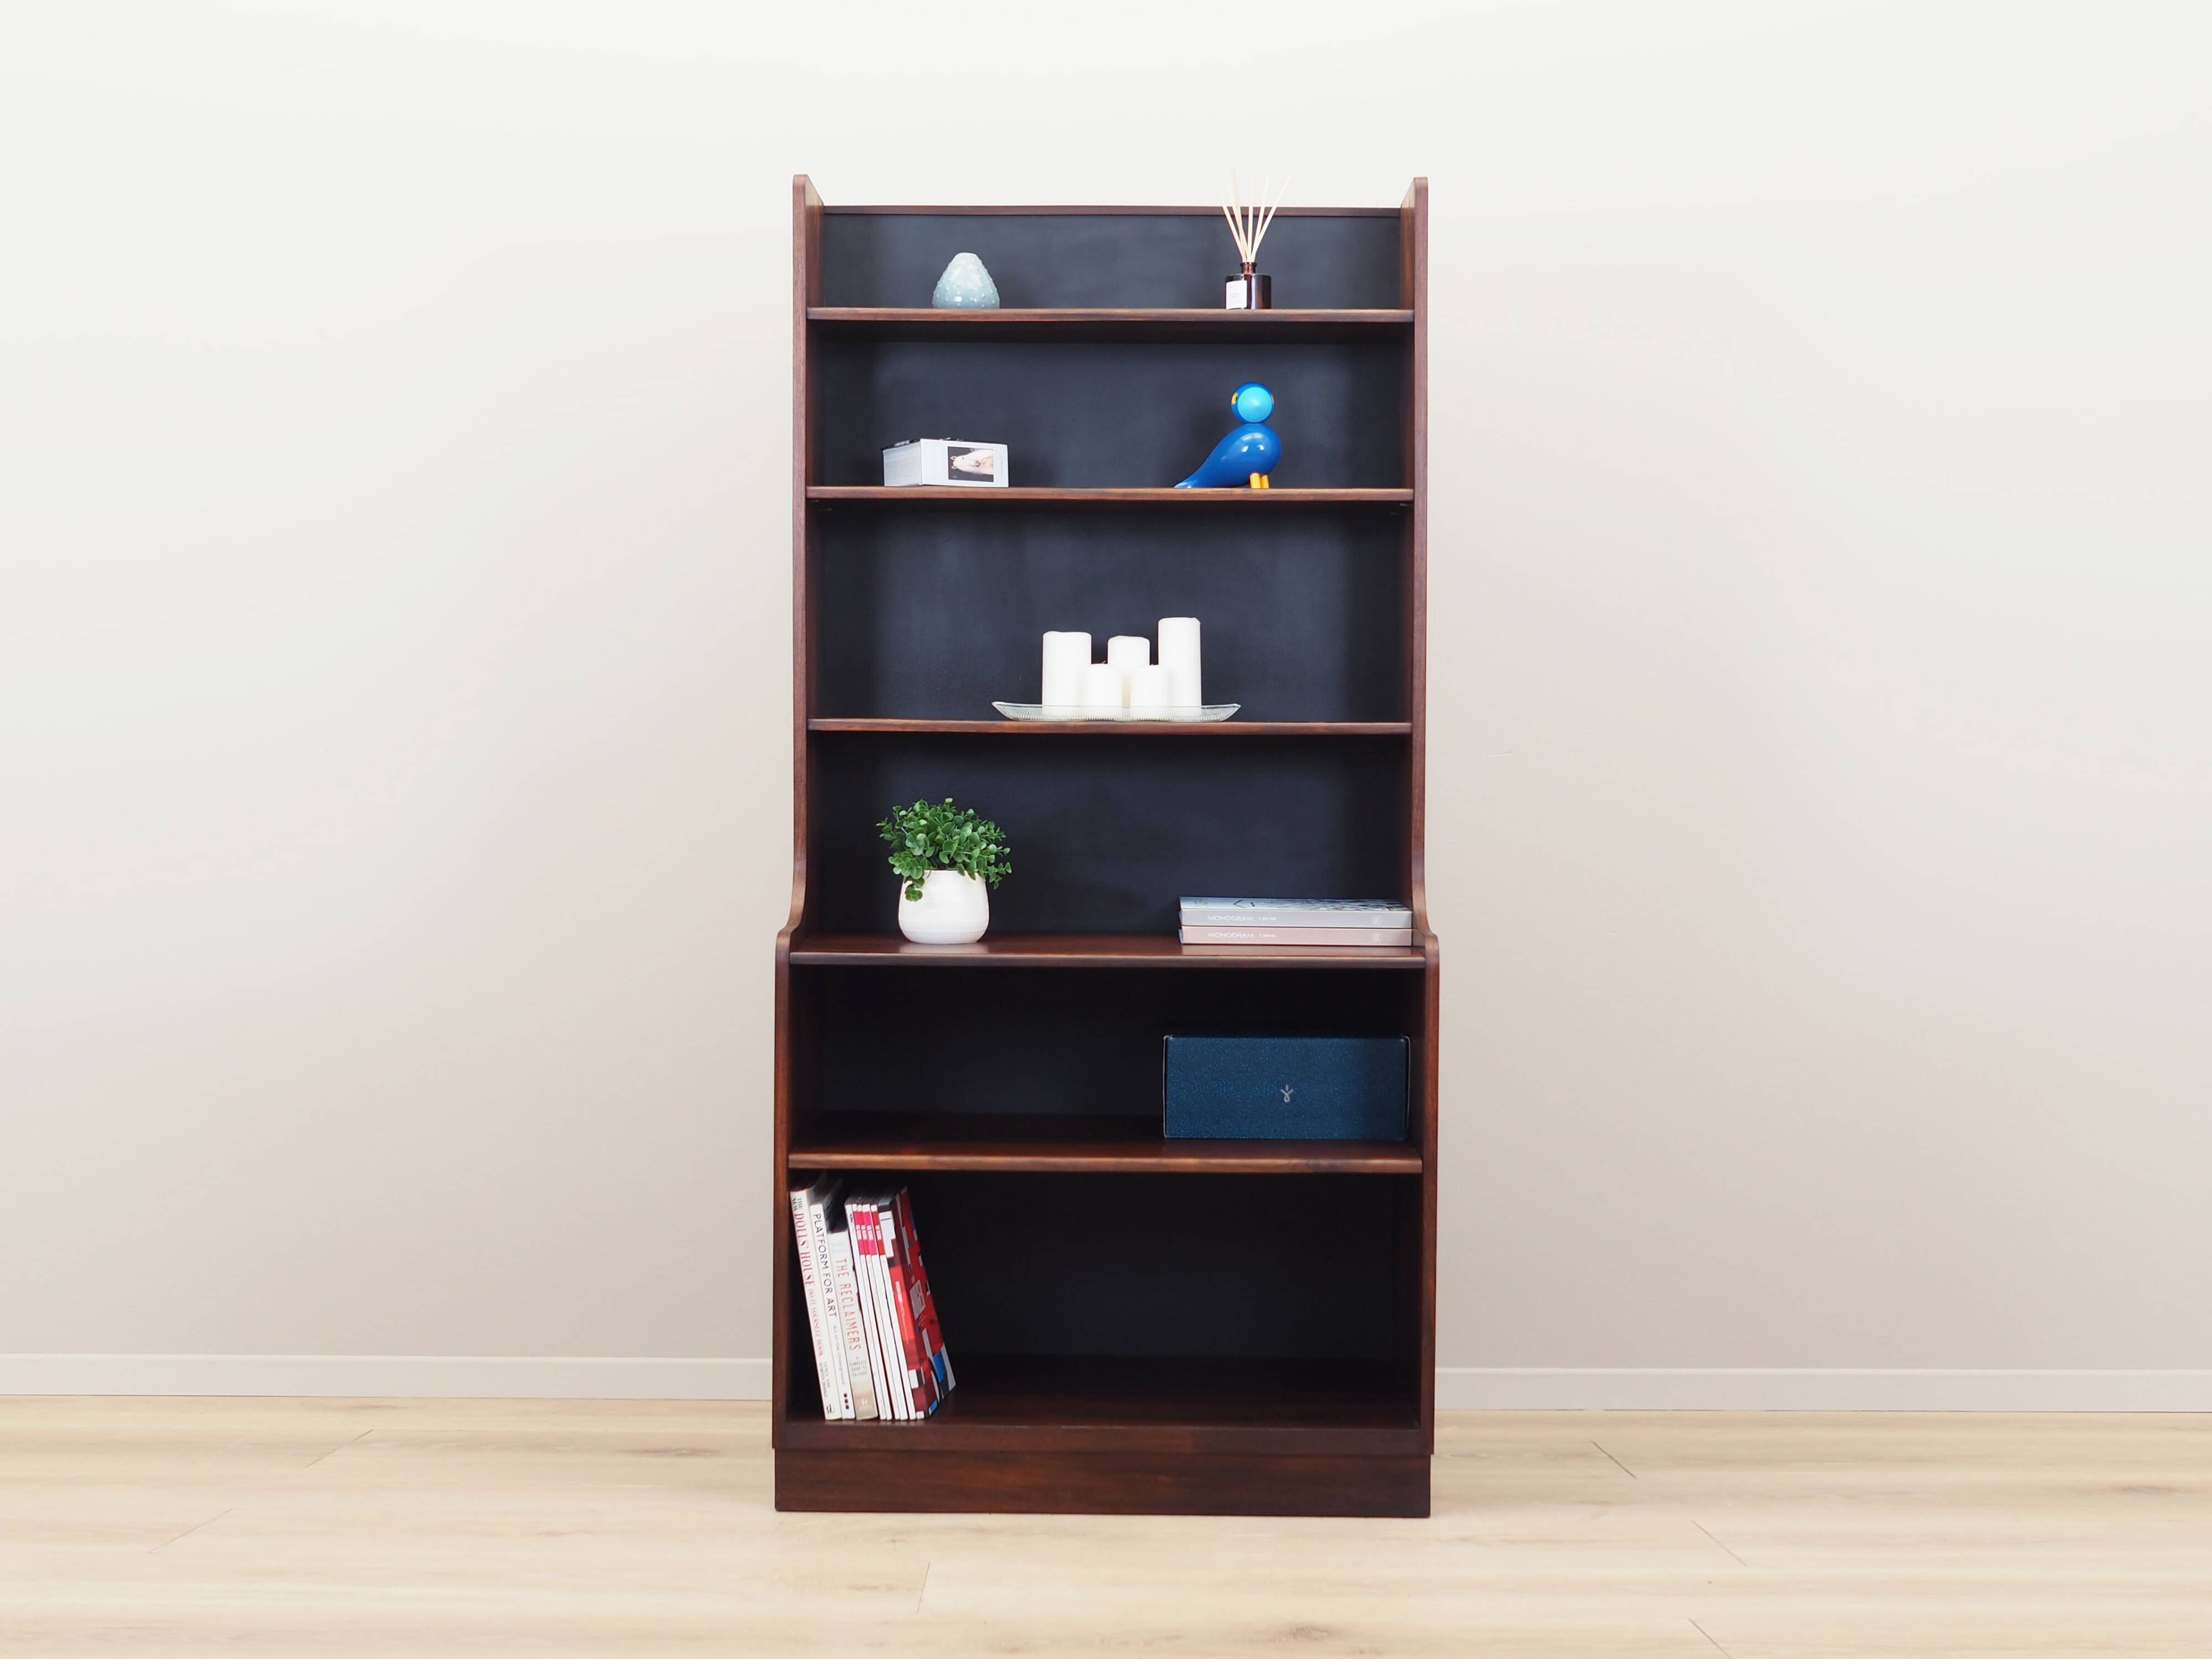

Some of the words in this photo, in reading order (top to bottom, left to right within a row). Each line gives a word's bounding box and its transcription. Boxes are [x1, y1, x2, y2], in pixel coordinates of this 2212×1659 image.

[813, 1213, 829, 1270] PLATFORM
[800, 1251, 815, 1286] HOUSE
[836, 1258, 849, 1278] THE
[823, 1273, 833, 1294] FOR
[827, 1298, 837, 1317] ART
[839, 1284, 861, 1350] RECLAIMERS
